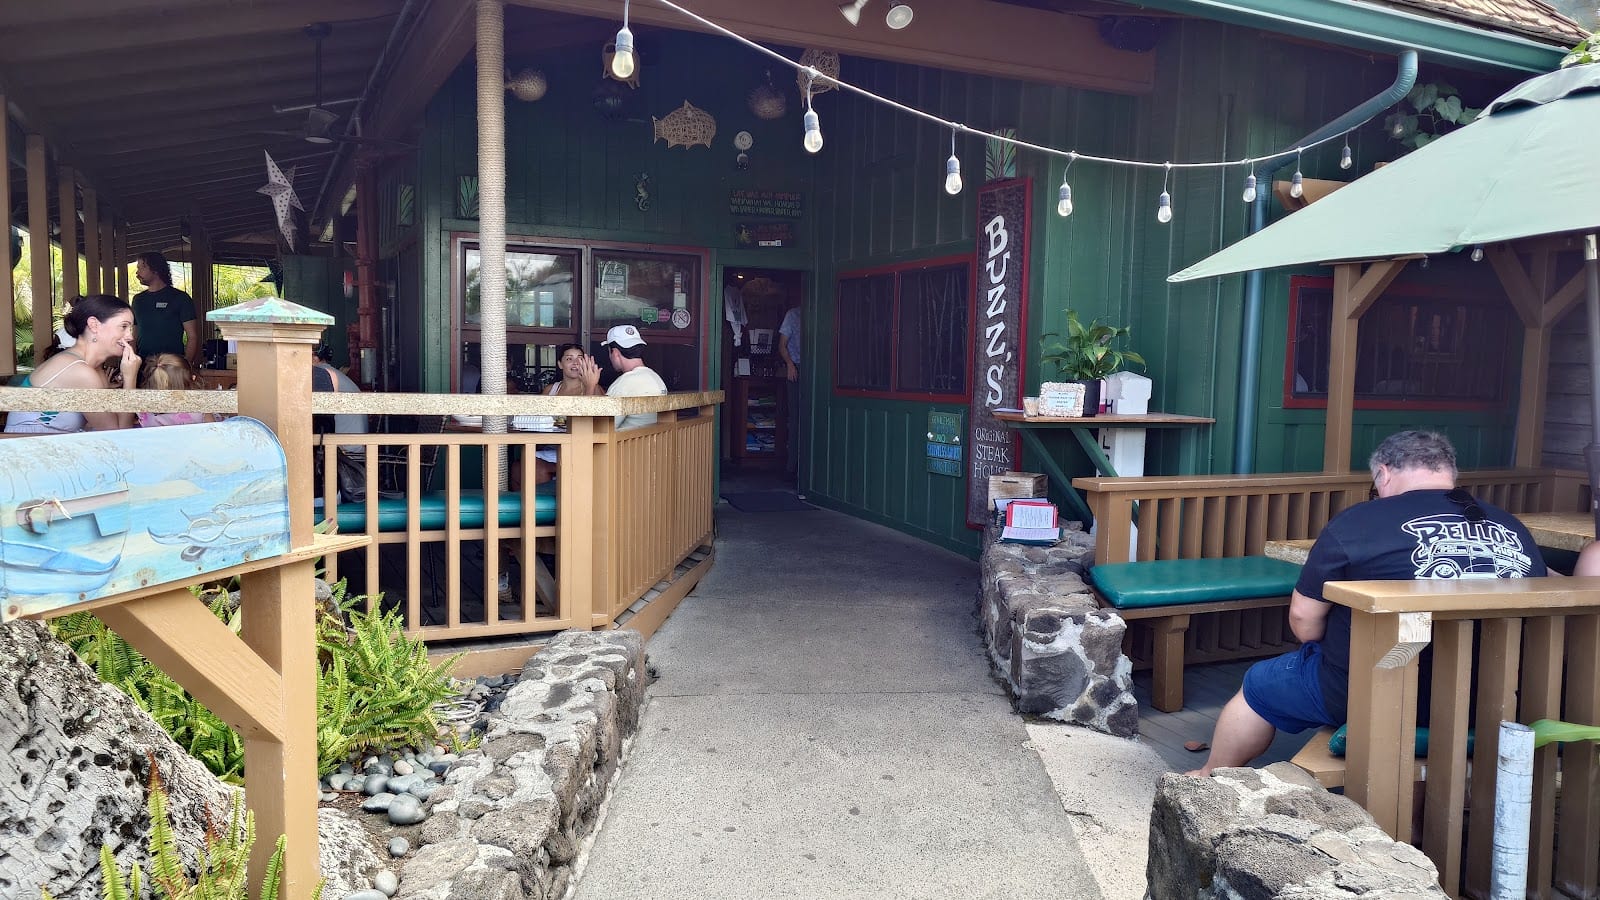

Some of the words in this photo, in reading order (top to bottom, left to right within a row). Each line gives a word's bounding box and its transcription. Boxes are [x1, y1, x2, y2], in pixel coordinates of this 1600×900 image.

[985, 215, 1012, 407] BUZZ'S
[975, 427, 1012, 444] ORIGINAL
[976, 444, 1010, 463] STEAK
[1407, 521, 1521, 553] BELLO'S
